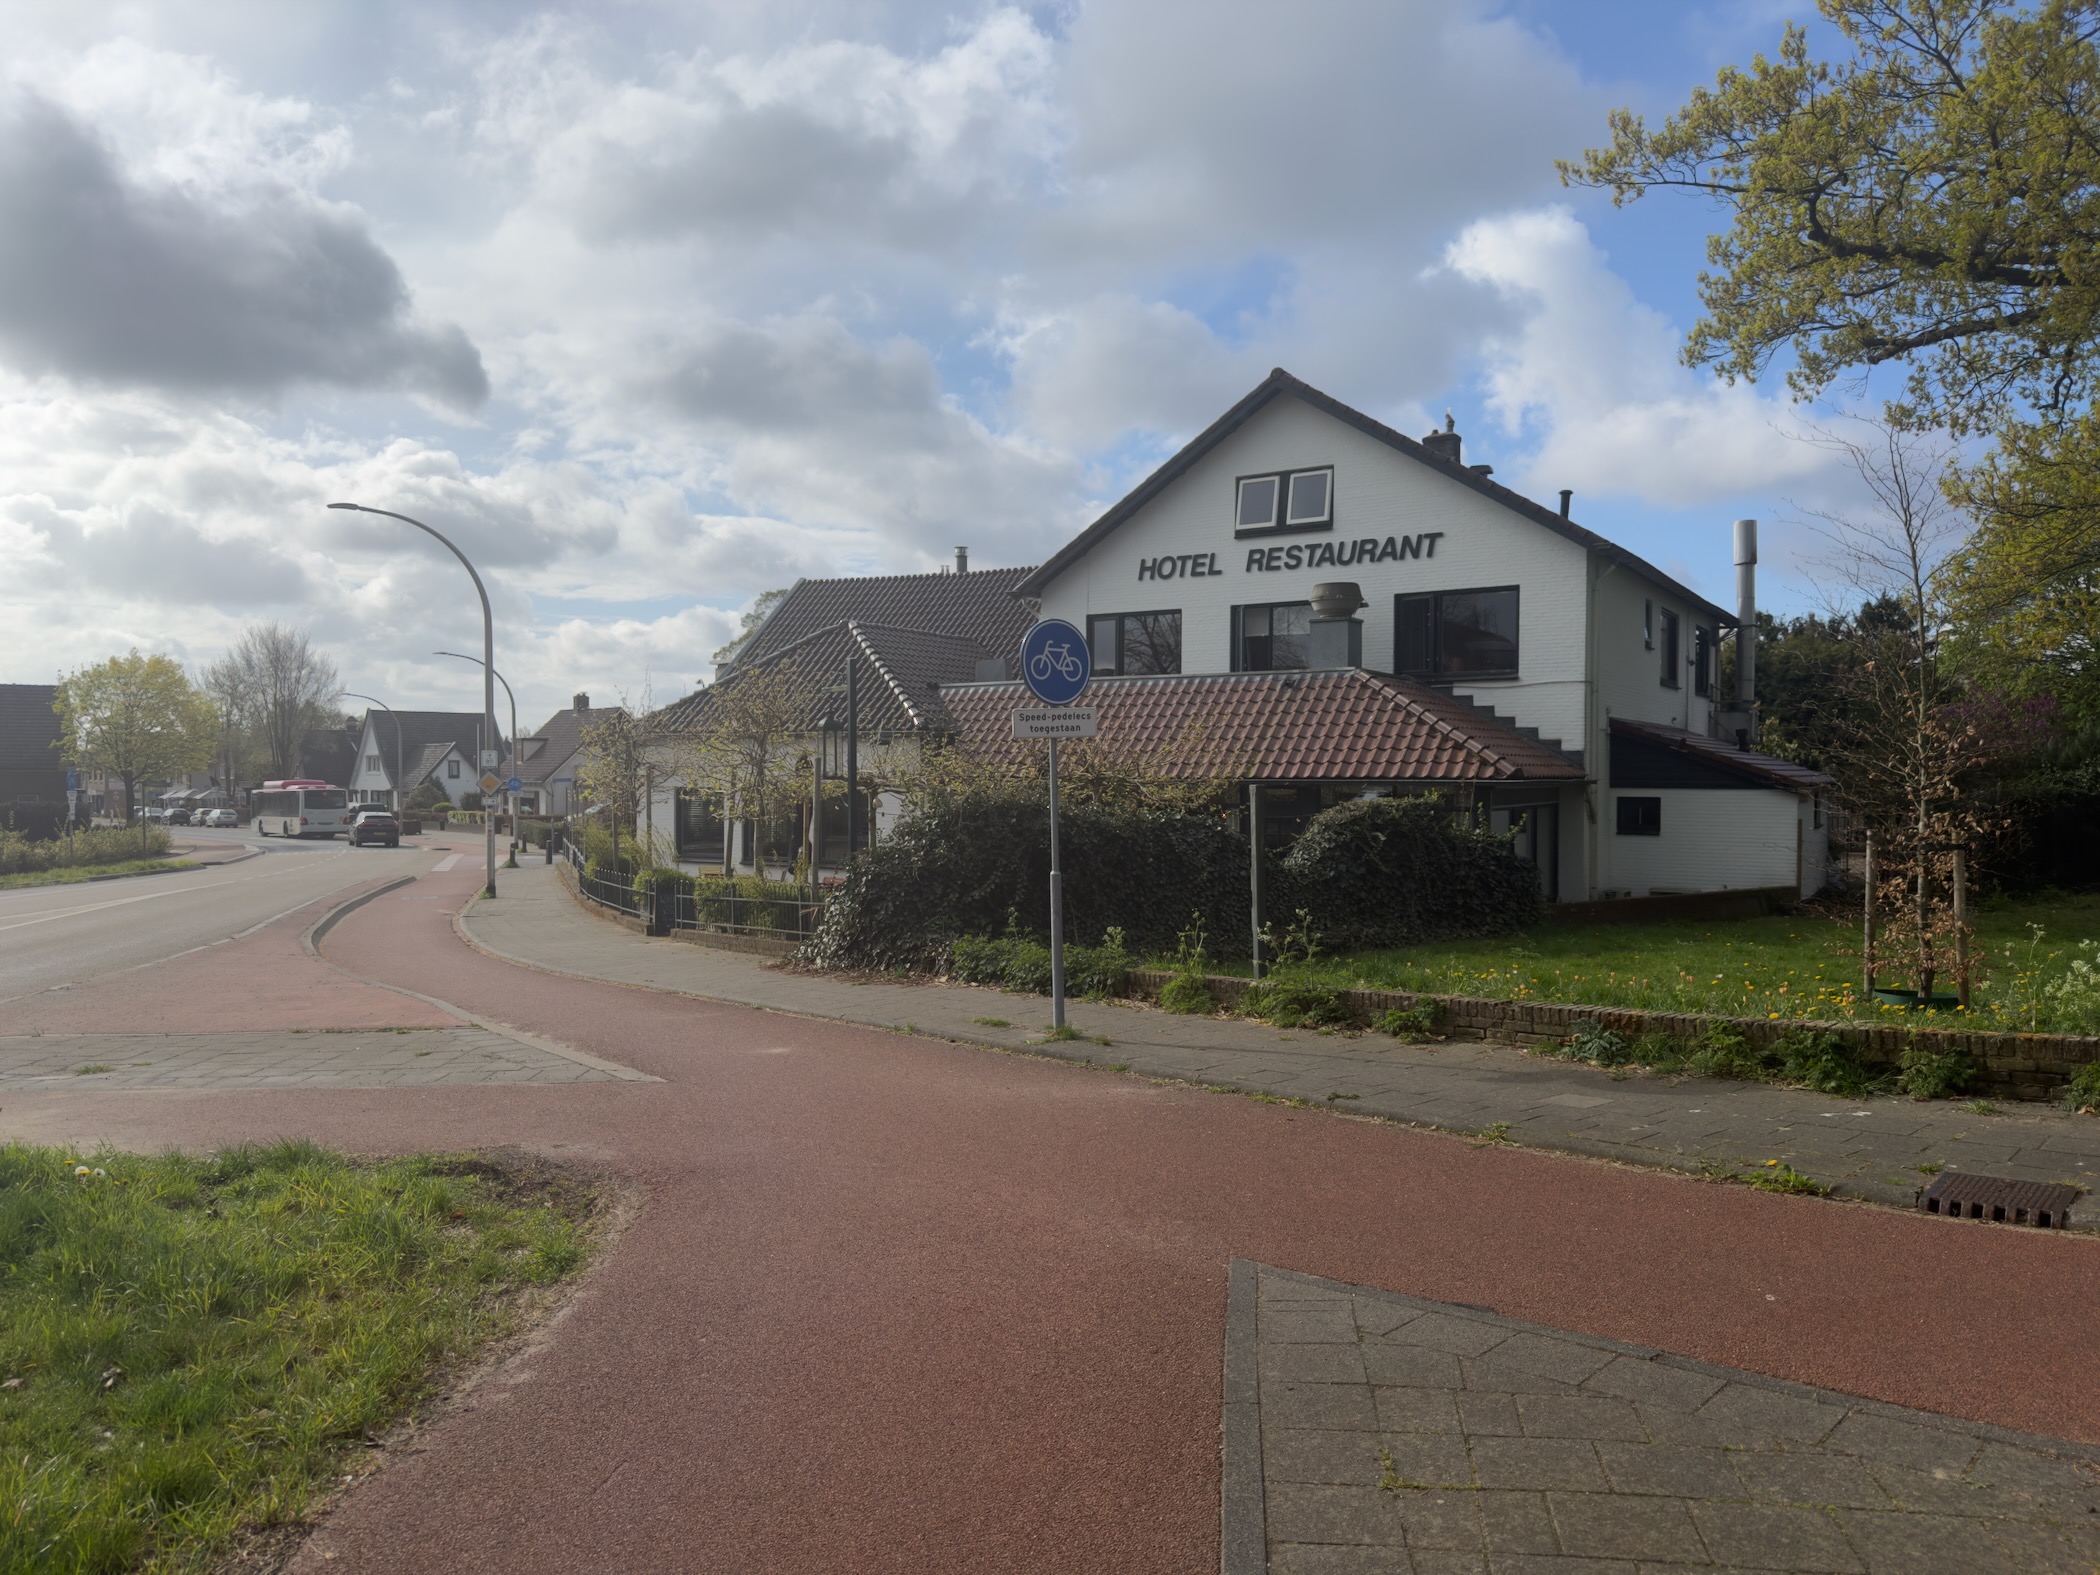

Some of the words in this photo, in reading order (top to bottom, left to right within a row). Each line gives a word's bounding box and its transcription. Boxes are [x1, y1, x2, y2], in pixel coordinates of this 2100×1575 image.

[1139, 553, 1222, 581] HOTEL
[1246, 532, 1443, 572] RESTAURANT
[1019, 713, 1091, 722] Speed-pedelecs
[1030, 724, 1081, 734] toegestaan
